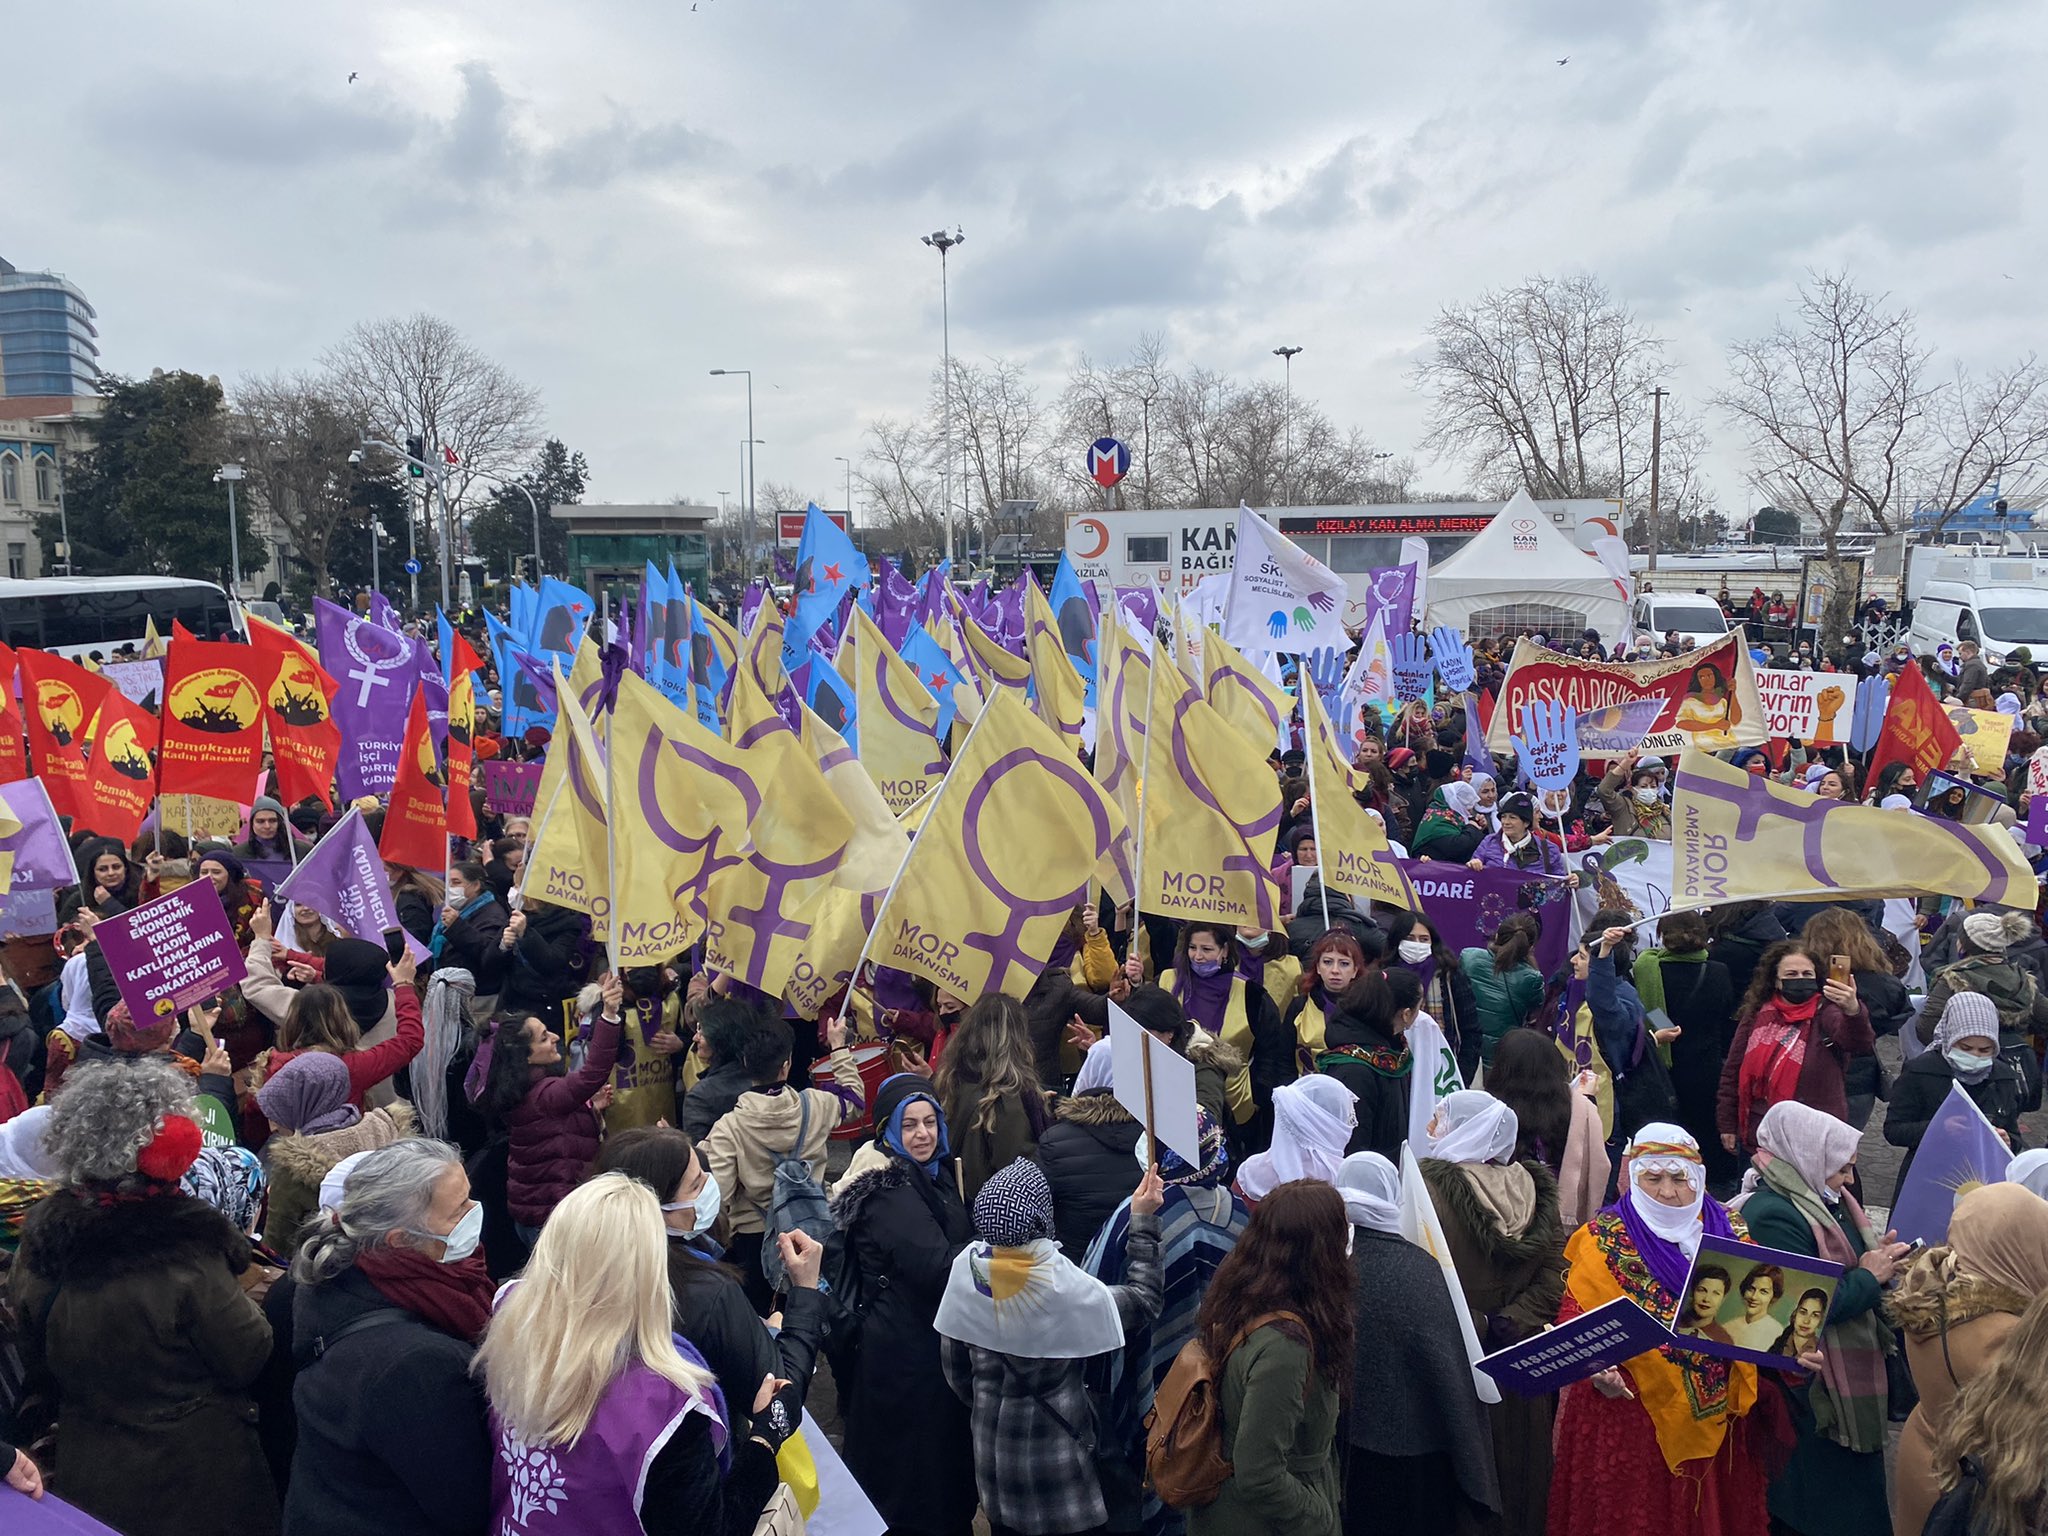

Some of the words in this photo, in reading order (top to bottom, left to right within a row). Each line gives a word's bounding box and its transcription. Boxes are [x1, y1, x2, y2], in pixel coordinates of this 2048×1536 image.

[1316, 520, 1365, 531] KIZILAY
[1370, 519, 1396, 530] KAN
[1399, 519, 1437, 530] ALMA
[1260, 563, 1283, 578] SK
[1398, 692, 1417, 702] PED
[162, 750, 197, 762] Kadın
[200, 752, 251, 764] Hareketi
[163, 739, 252, 755] Demokratik
[359, 750, 380, 763] İŞÇİ
[1533, 763, 1567, 778] ücret
[1534, 754, 1559, 767] eşit
[881, 779, 927, 796] MOR
[1338, 850, 1384, 881] MOR
[1161, 869, 1226, 899] MOR
[1335, 870, 1402, 898] DAYANIŞMA
[128, 896, 184, 927] ŞİDDETE,
[1160, 894, 1248, 916] DAYANIŞMA
[129, 903, 194, 940] EKONOMİK
[147, 922, 188, 946] KRİZE,
[152, 932, 191, 957] KADIN
[898, 918, 960, 966] MOR
[126, 930, 224, 982] KATLİAMLARINA
[162, 954, 200, 979] KARŞI
[892, 943, 969, 992] DAYANIŞMA
[145, 956, 223, 1000] SOKAKTAYIZ!
[795, 954, 828, 998] OR
[1509, 1340, 1576, 1371] YAŞASIN
[1574, 1318, 1623, 1348] KADIN
[1528, 1331, 1631, 1379] DAYANIŞMASI
